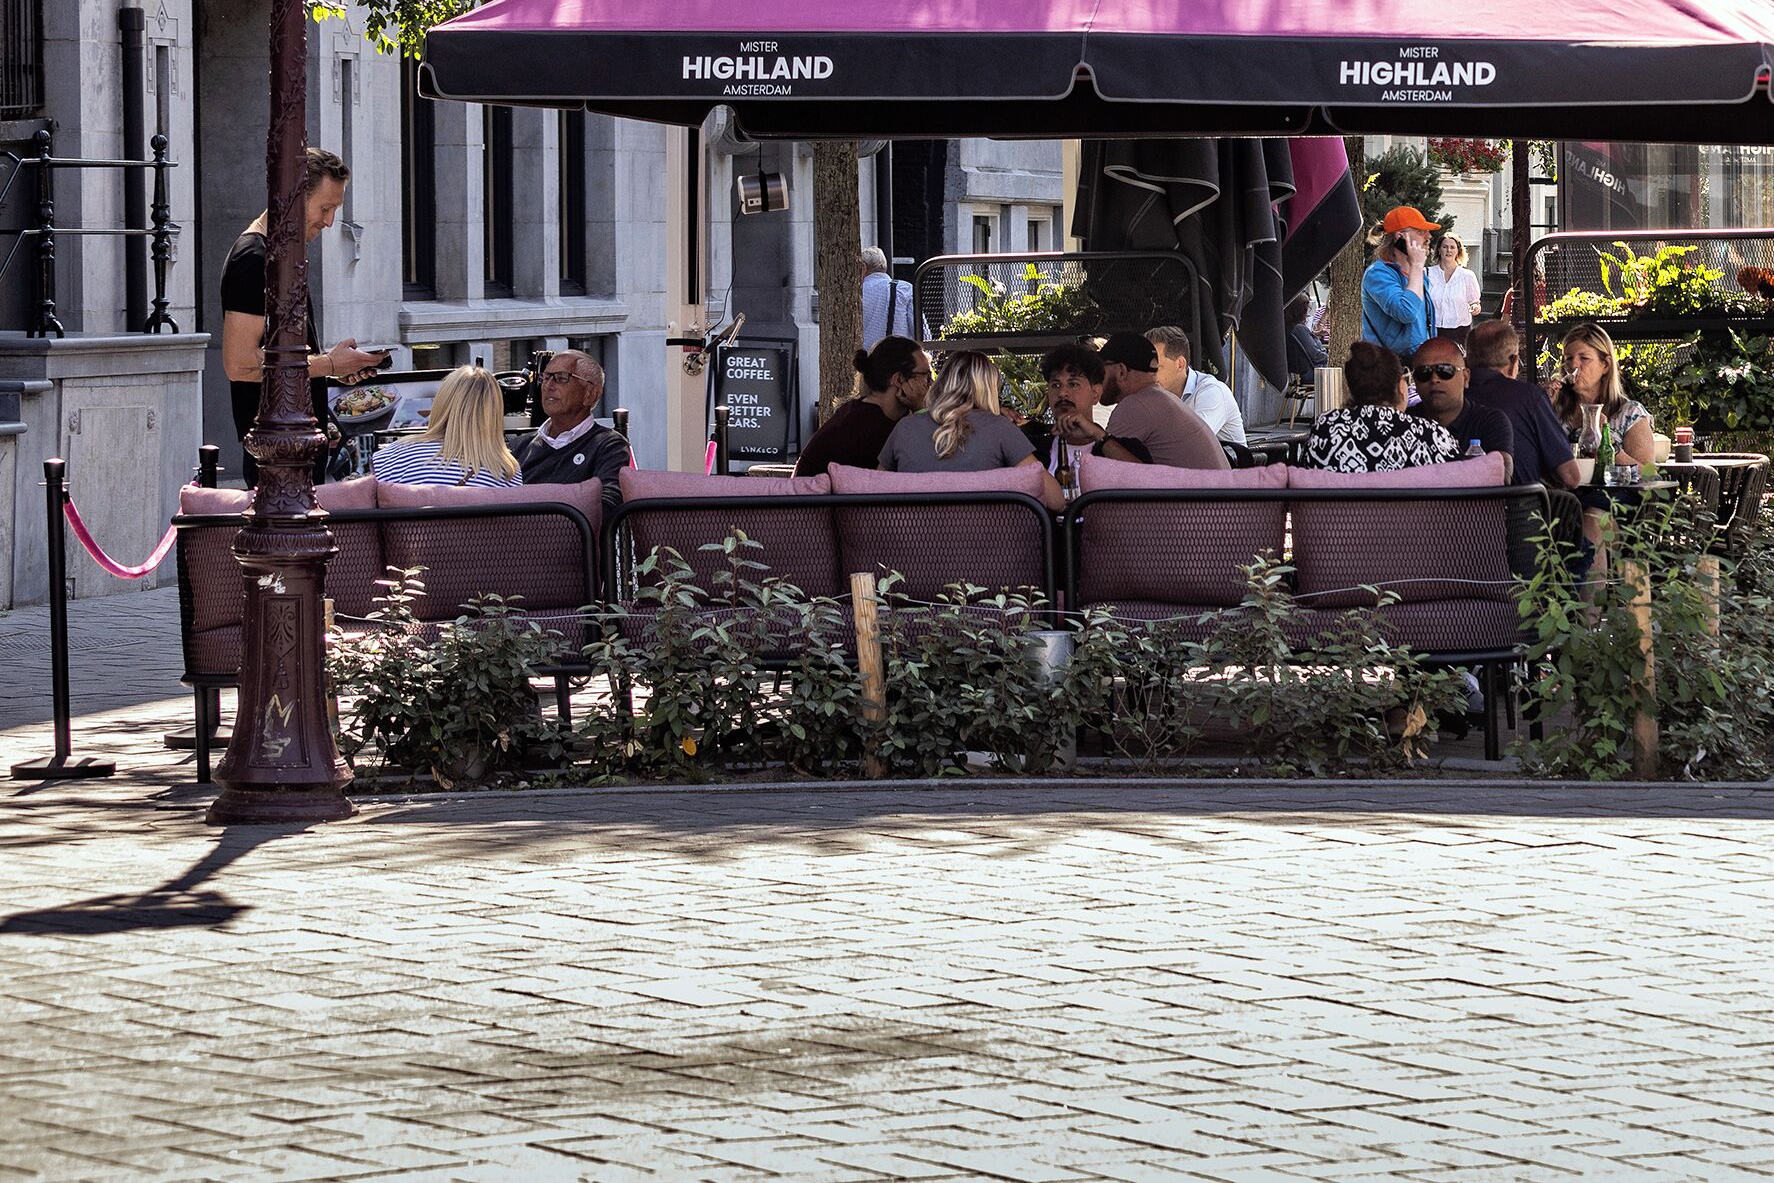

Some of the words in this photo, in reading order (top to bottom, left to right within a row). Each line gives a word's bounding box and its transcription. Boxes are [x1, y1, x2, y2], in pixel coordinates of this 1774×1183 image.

[740, 41, 778, 52] MISTER
[1400, 47, 1439, 58] MISTER
[682, 56, 834, 79] HIGHLAND
[1339, 61, 1496, 86] HIGHLAND
[723, 85, 792, 95] AMSTERDAM
[1381, 90, 1452, 101] AMSTERDAM
[726, 356, 766, 368] GREAT
[726, 368, 774, 380] COFFEE.
[727, 393, 758, 404] EVEN
[728, 405, 771, 417] BETTER
[728, 417, 760, 428] CARS.
